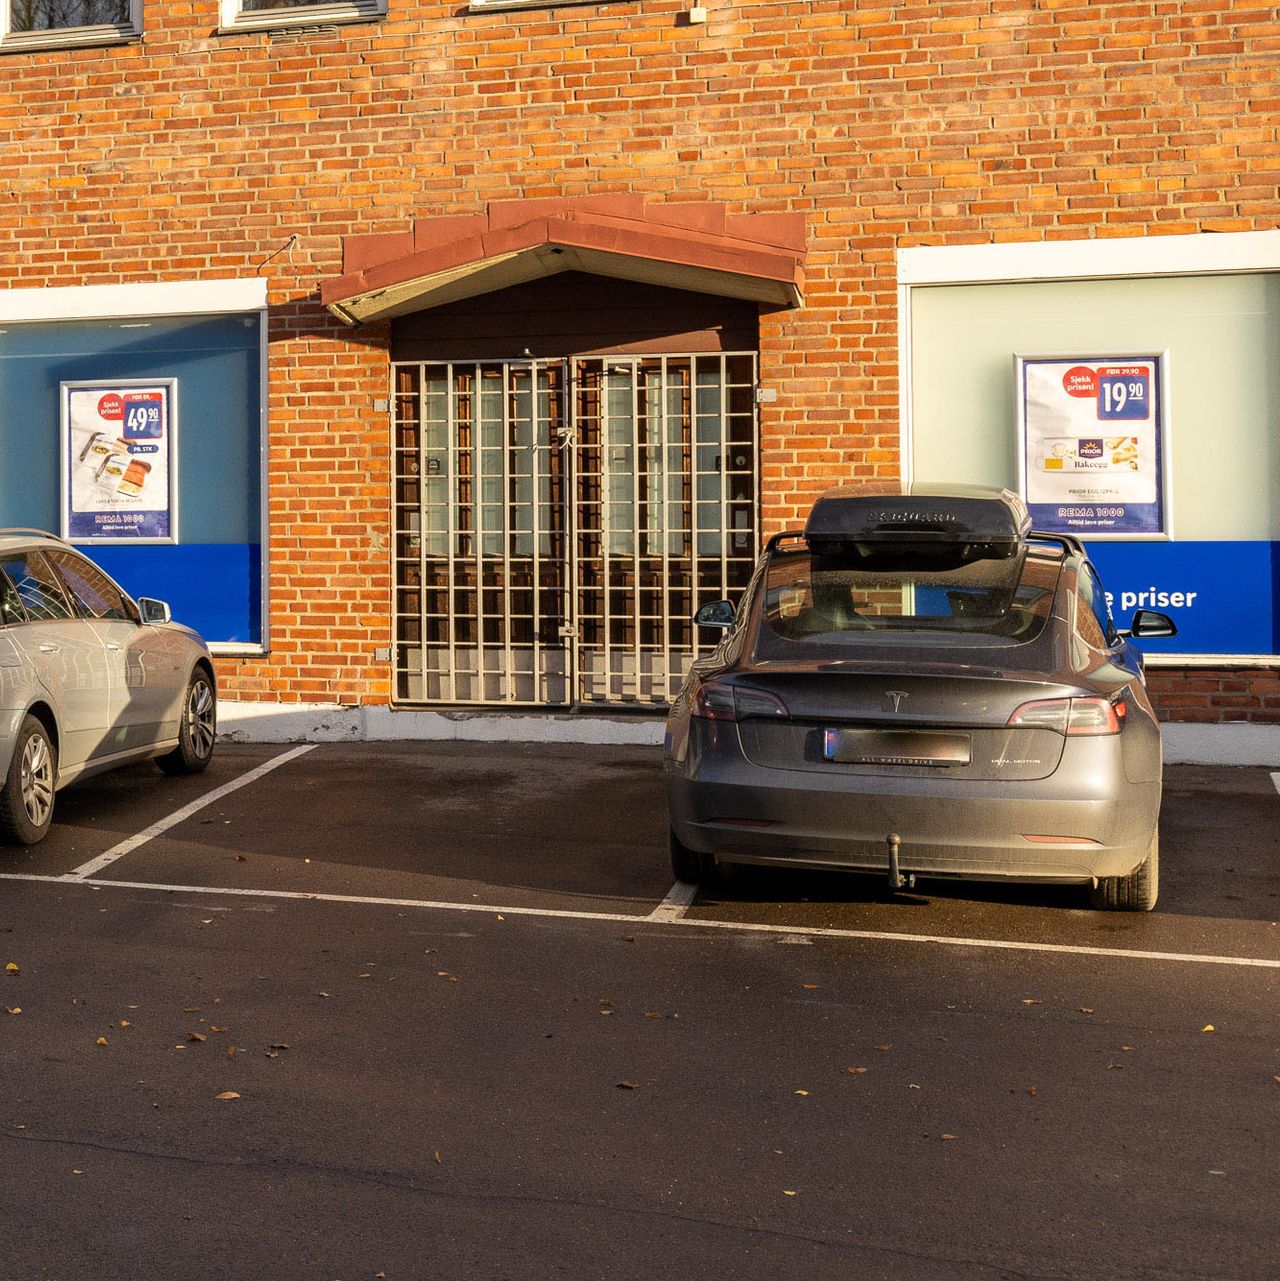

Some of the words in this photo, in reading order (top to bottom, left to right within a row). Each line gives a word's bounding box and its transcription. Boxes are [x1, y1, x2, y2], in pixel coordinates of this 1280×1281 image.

[1070, 375, 1091, 384] Sjekk
[1067, 383, 1095, 391] prisen!
[1102, 382, 1127, 412] 19
[1128, 382, 1144, 397] 90
[103, 401, 119, 409] Sjekk
[127, 407, 148, 431] 49
[148, 407, 159, 419] 90
[1058, 507, 1095, 517] REMA
[1096, 506, 1125, 517] 1000
[95, 514, 122, 524] REMA
[122, 514, 145, 523] 1000
[1121, 586, 1198, 611] priser
